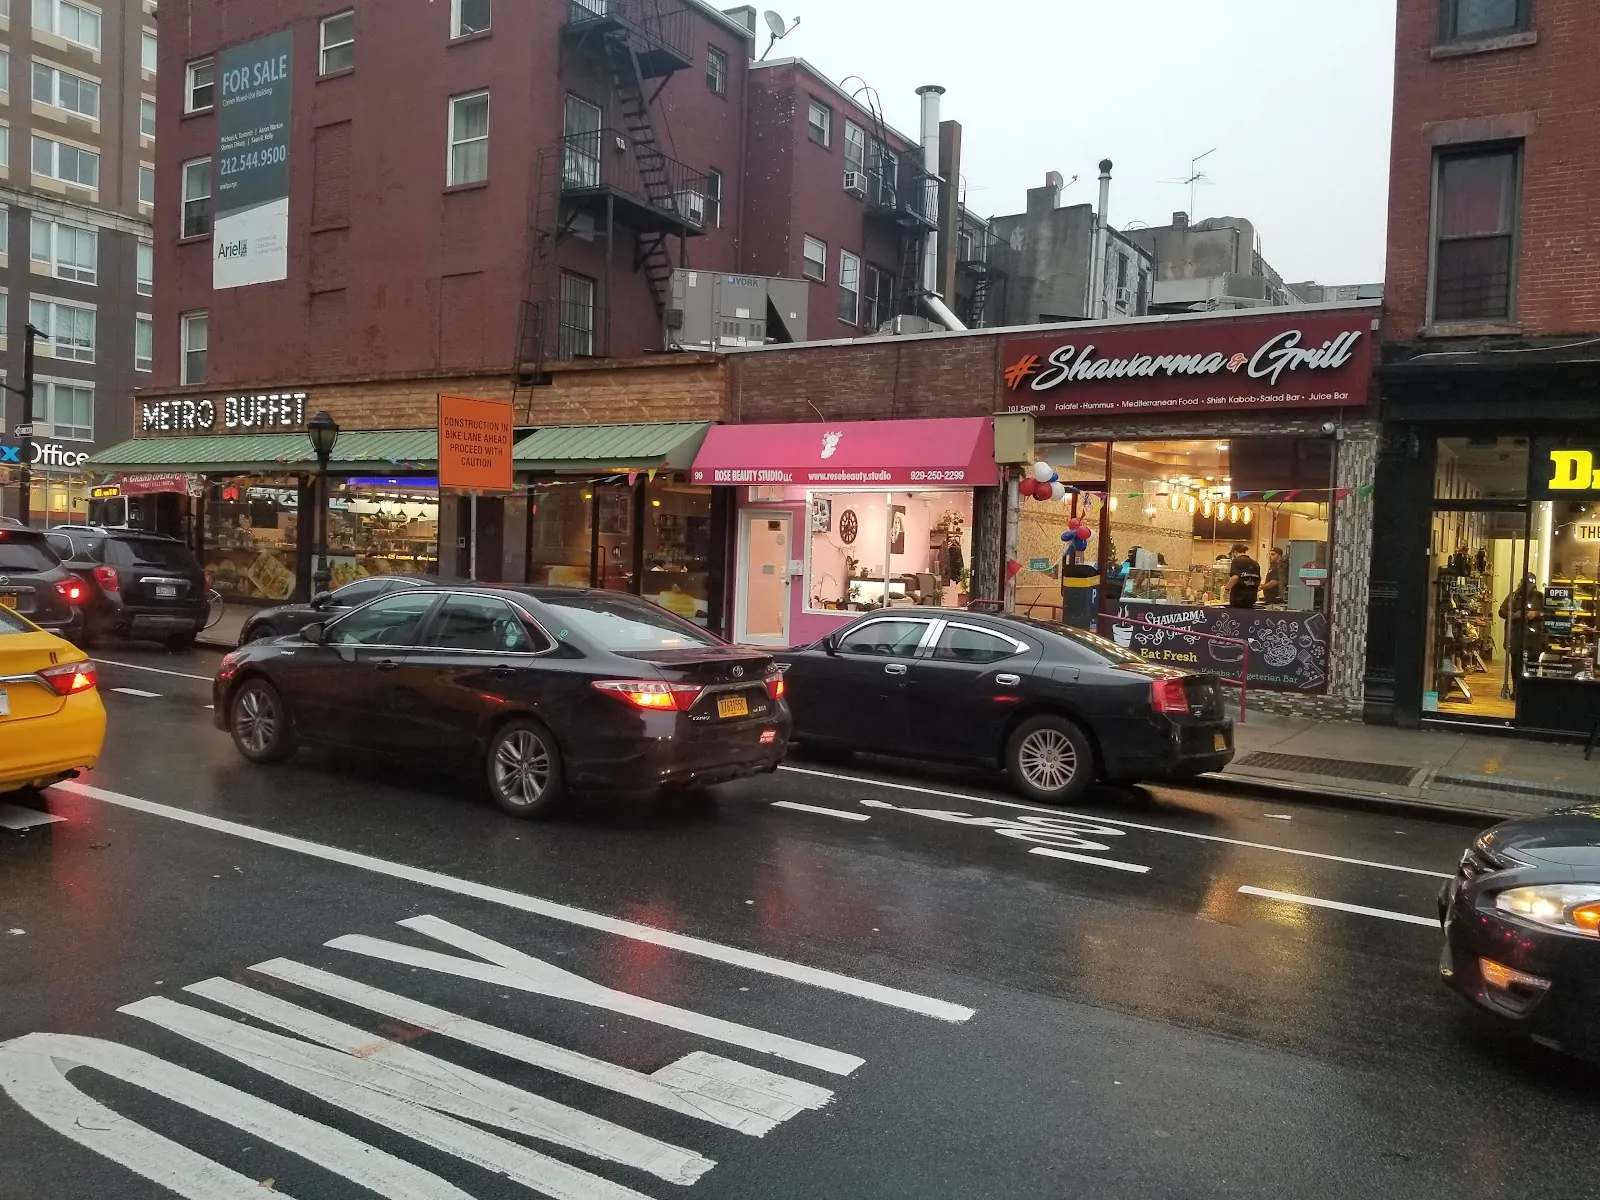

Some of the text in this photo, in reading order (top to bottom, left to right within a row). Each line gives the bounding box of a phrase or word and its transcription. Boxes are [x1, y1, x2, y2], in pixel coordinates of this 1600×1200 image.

[222, 54, 287, 95] FOR SALE
[256, 87, 273, 99] Building
[220, 144, 286, 175] 212.544.9500
[217, 240, 241, 259] Ariel
[735, 277, 759, 288] YORK
[1248, 329, 1362, 385] Grill
[1007, 391, 1349, 413] 101 Smith St Falafel Hummus Mediterranean Food Shish Kabob Salad Bar Juice Bar
[142, 393, 306, 431] METRO BUFFET
[444, 416, 509, 432] CONSTRUCTION IN
[445, 430, 507, 444] BIKE LANE AHEAD
[449, 443, 503, 457] PROCEED WITH
[461, 456, 492, 468] CAUTION
[694, 471, 704, 480] 99
[714, 470, 731, 482] ROSE
[732, 470, 757, 482] BEAUTY
[758, 469, 783, 482] STUDIO
[808, 469, 892, 482] www.rosebeauty.studio
[910, 470, 964, 481] 929-250-2299
[1549, 589, 1568, 597] OPEN
[1140, 648, 1198, 663] Eat Fresh
[1236, 670, 1281, 682] Vgeterian
[1284, 673, 1299, 684] Bar
[0, 914, 866, 1200] ONLY
